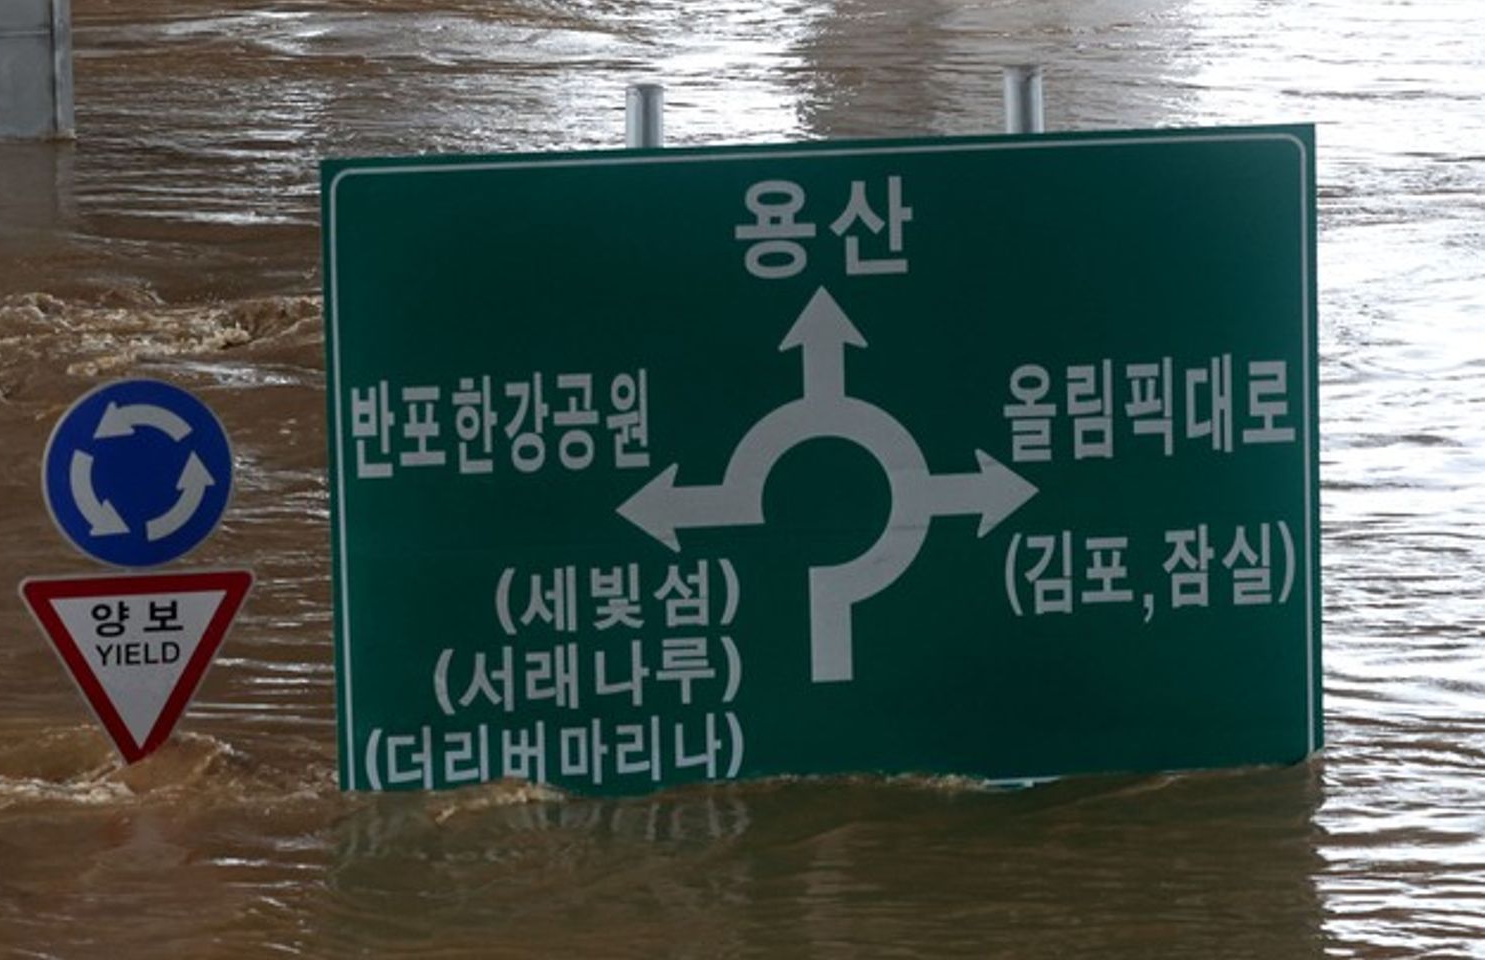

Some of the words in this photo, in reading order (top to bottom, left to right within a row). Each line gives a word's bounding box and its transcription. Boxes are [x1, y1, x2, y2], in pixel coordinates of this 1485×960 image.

[735, 176, 914, 279] 용산
[351, 368, 651, 479] 반포한강공원
[1002, 353, 1296, 464] 올림픽대로
[495, 558, 740, 635] (세빛섬)
[95, 641, 182, 667] YIELD
[434, 636, 743, 715] (서래나루)
[365, 712, 745, 790] (더리버마리나)
